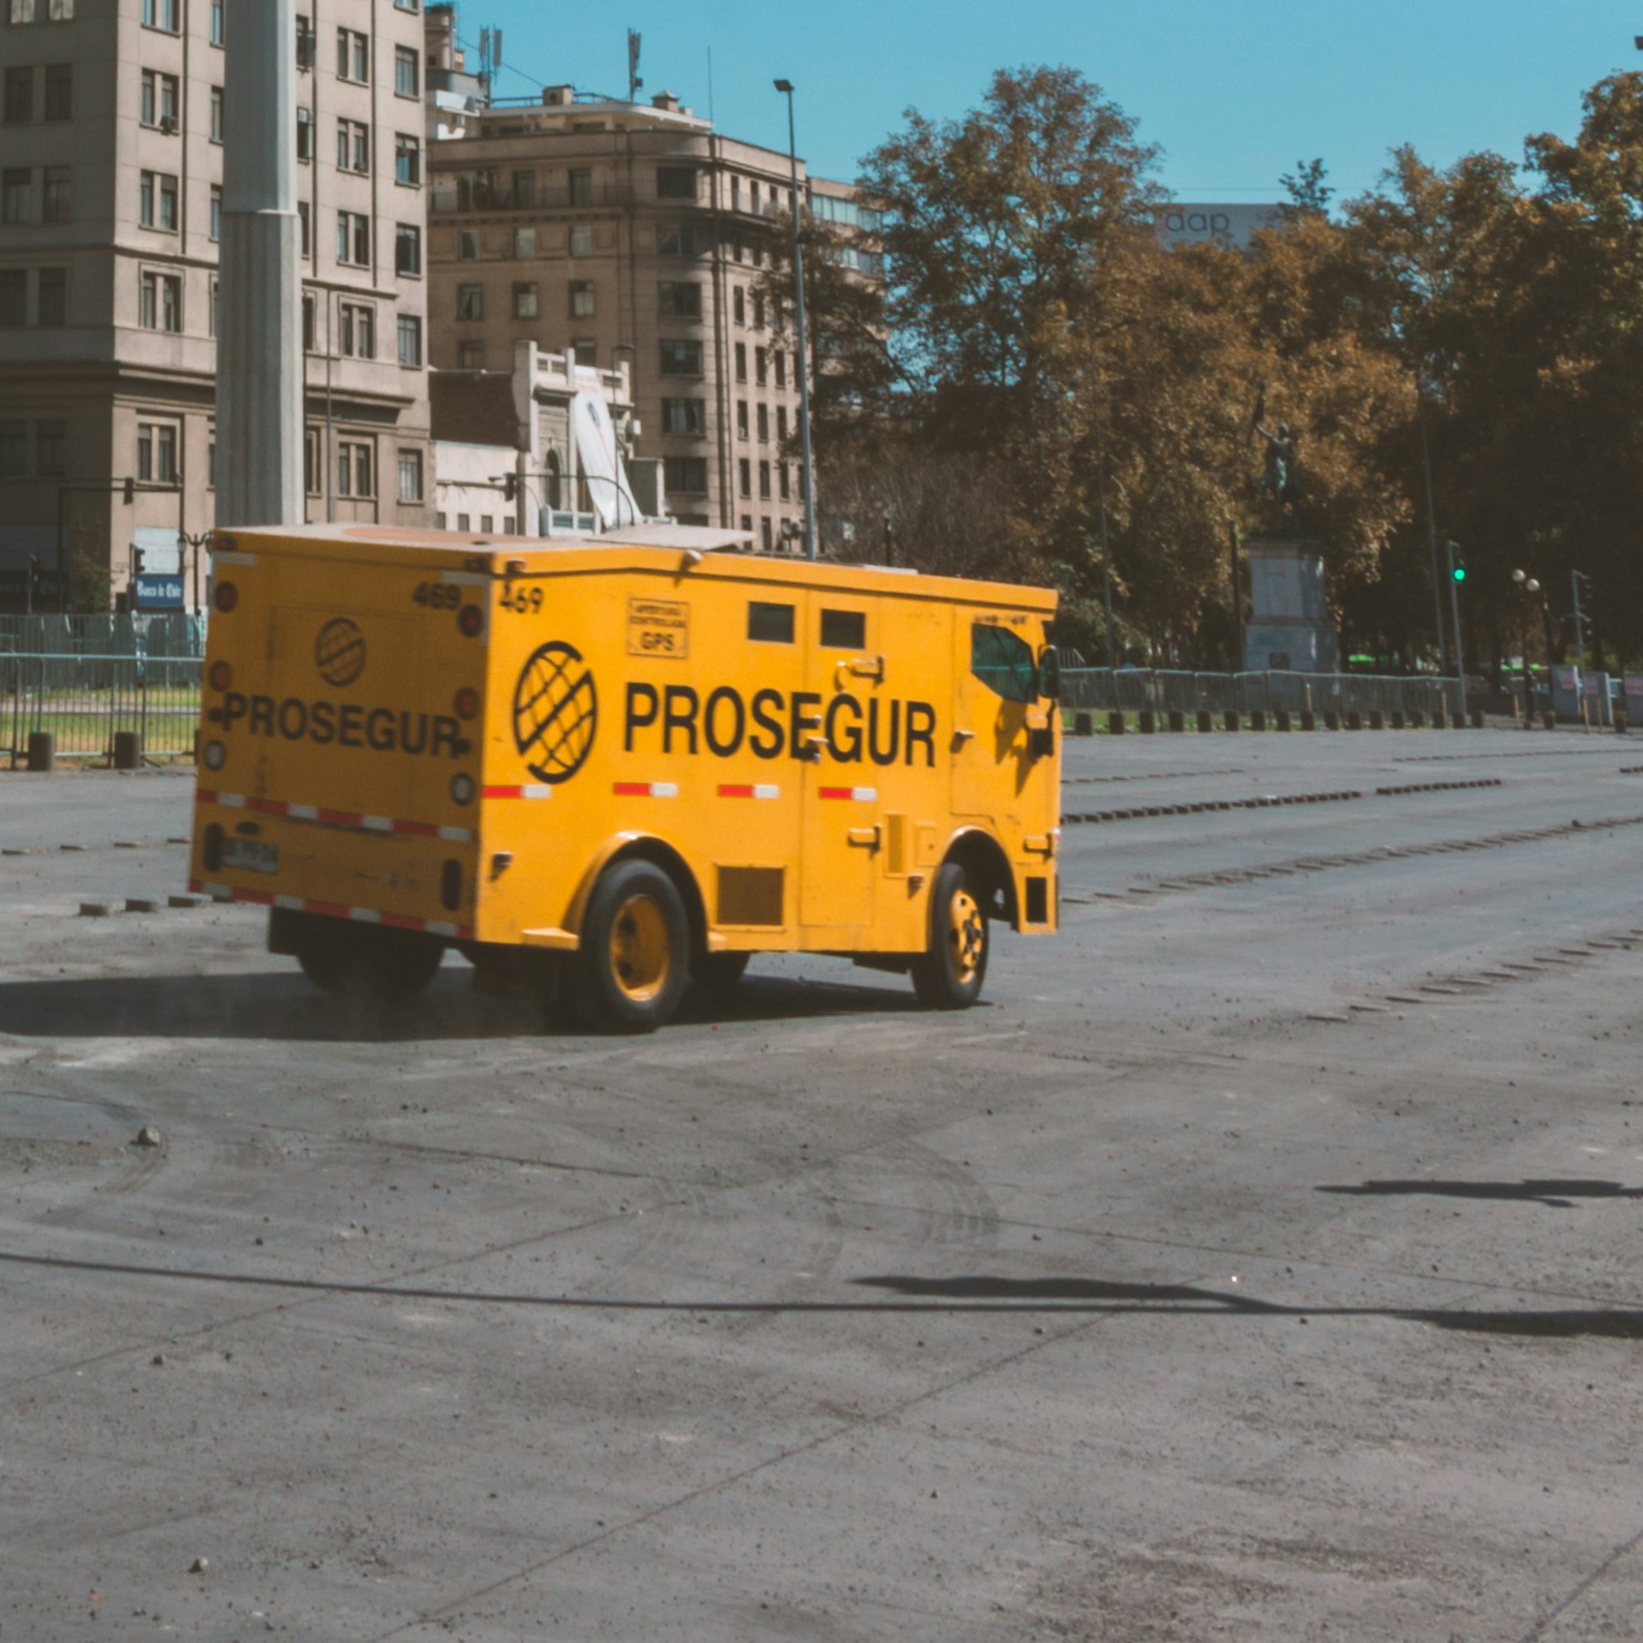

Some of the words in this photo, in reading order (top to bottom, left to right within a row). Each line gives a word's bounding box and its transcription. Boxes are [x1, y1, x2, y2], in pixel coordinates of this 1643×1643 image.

[500, 582, 544, 614] 469
[639, 631, 675, 652] GPS
[223, 691, 463, 759] PROSEGUR
[623, 681, 937, 768] PROSEGUR
